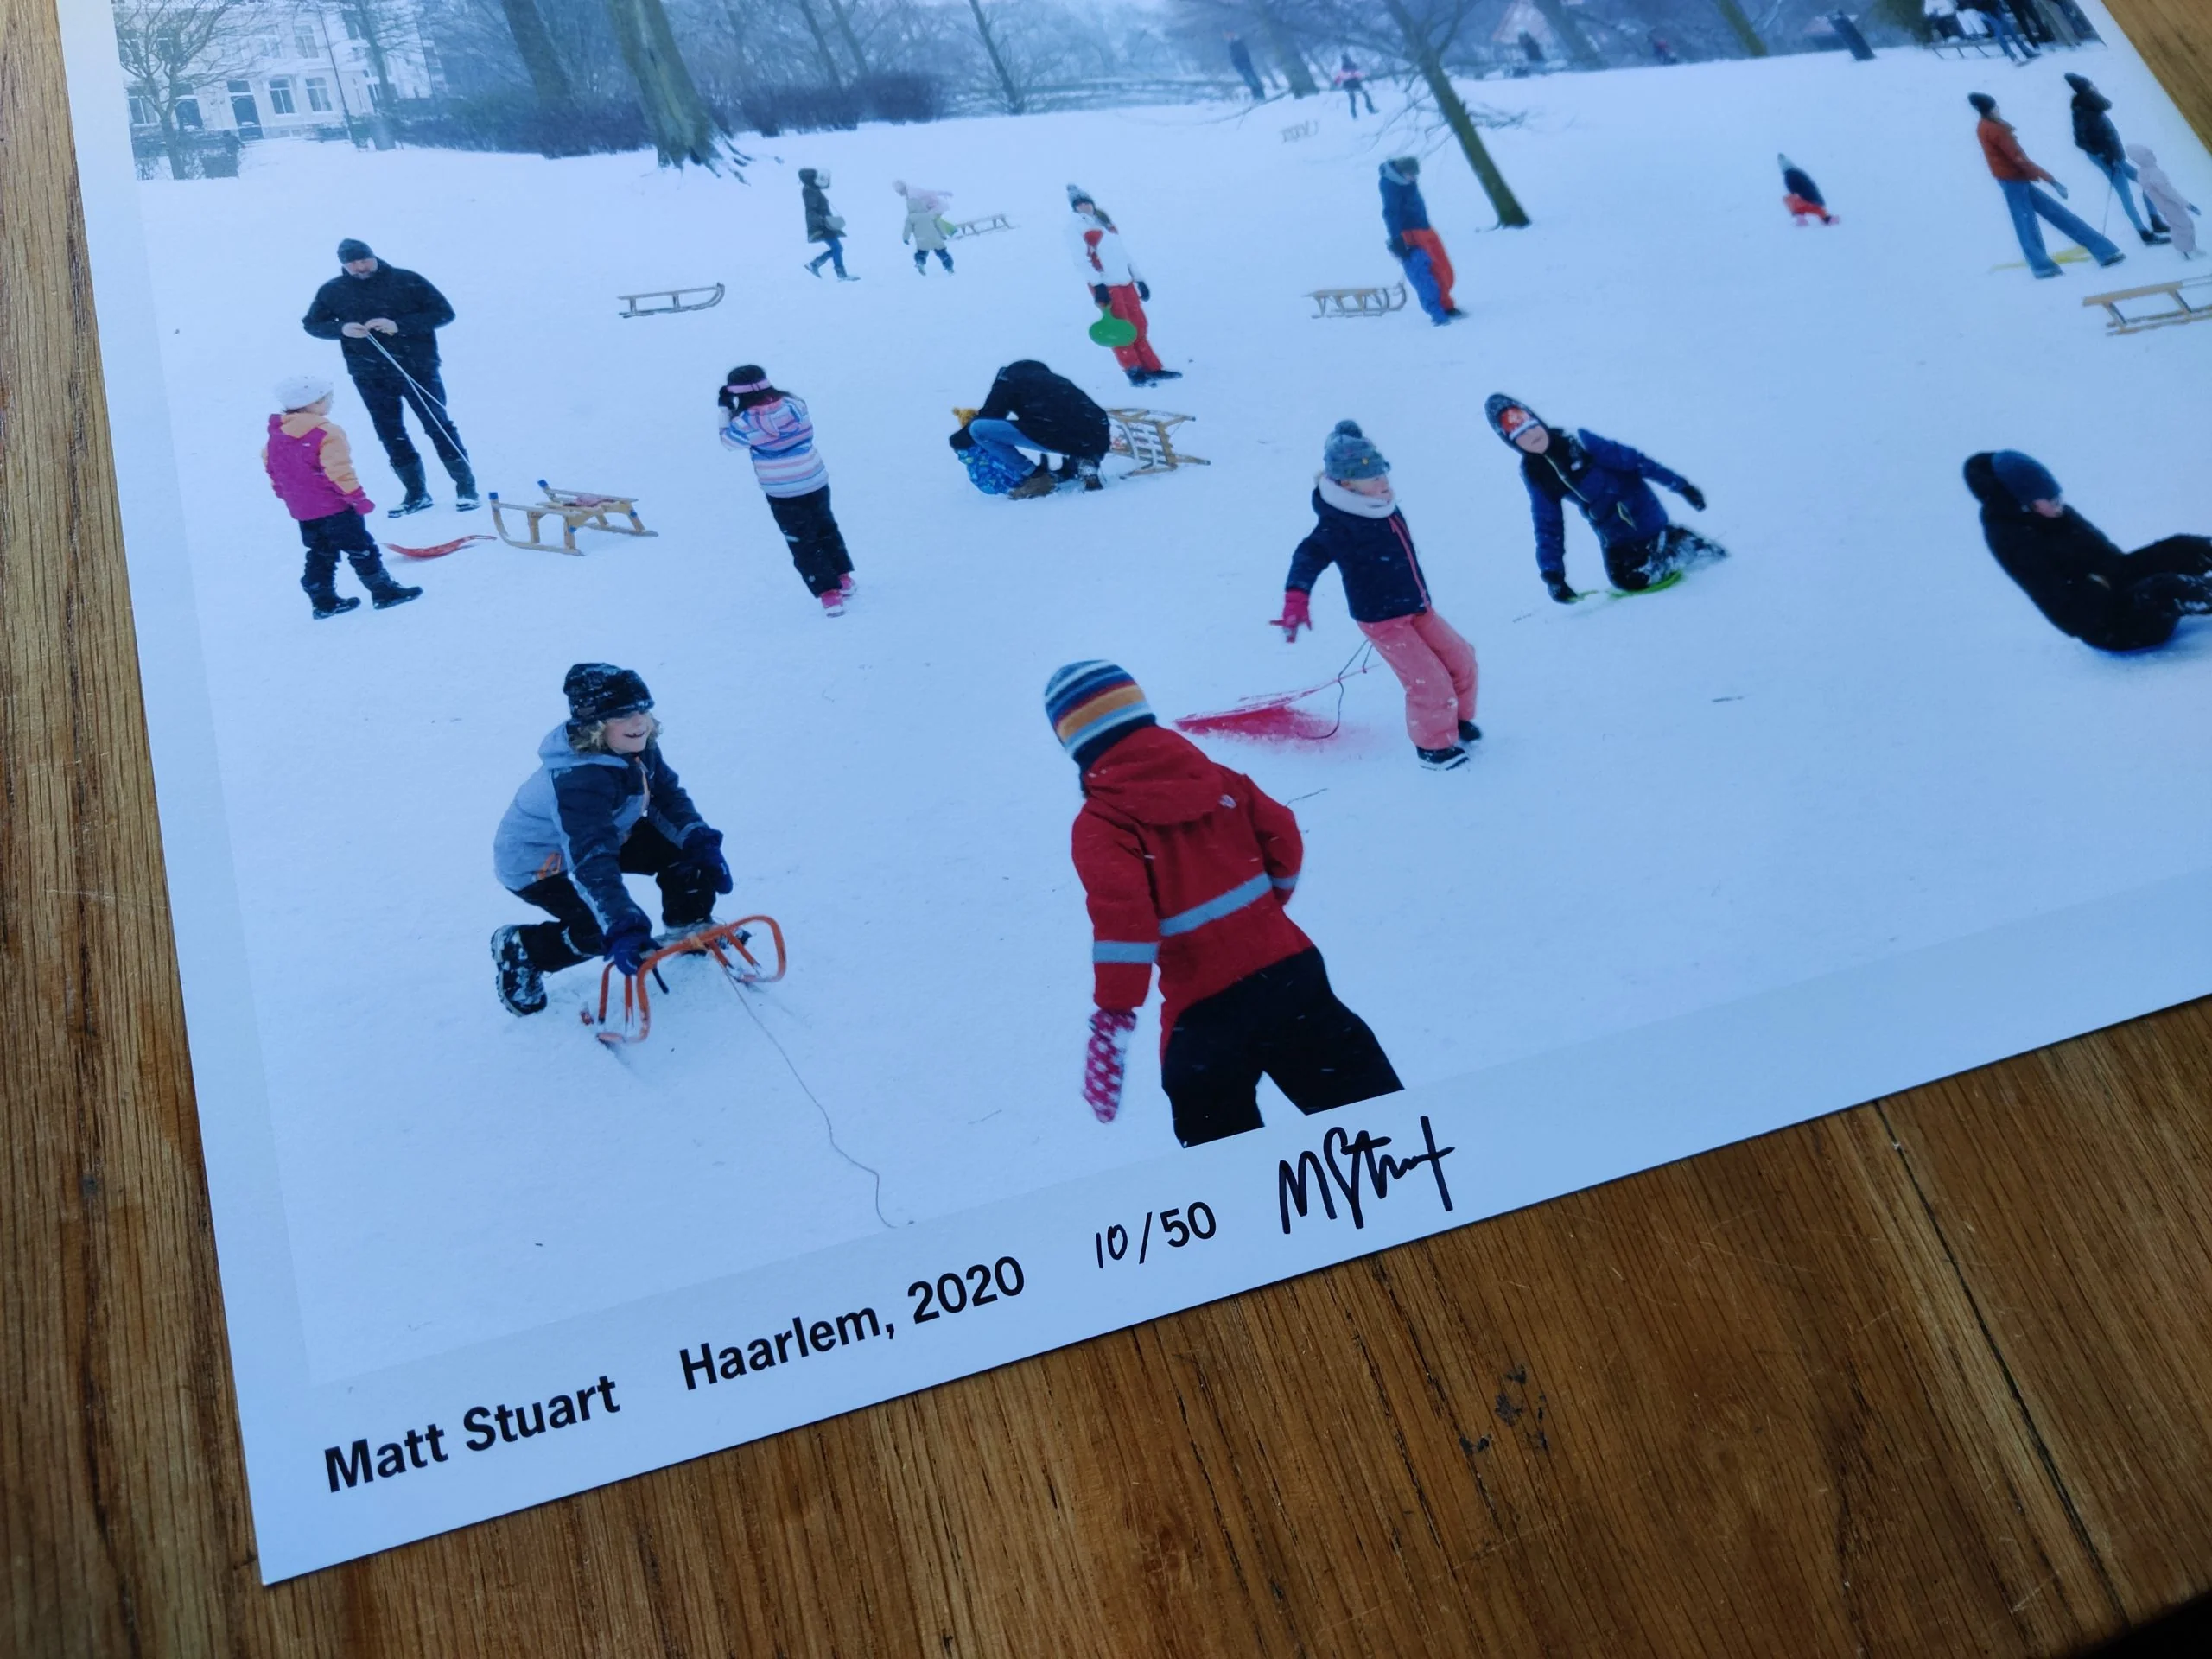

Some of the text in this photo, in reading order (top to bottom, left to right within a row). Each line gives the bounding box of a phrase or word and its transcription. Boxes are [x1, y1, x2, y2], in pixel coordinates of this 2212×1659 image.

[324, 1201, 1217, 1493] Matt Stuart Haarlem, 2020 10/50
